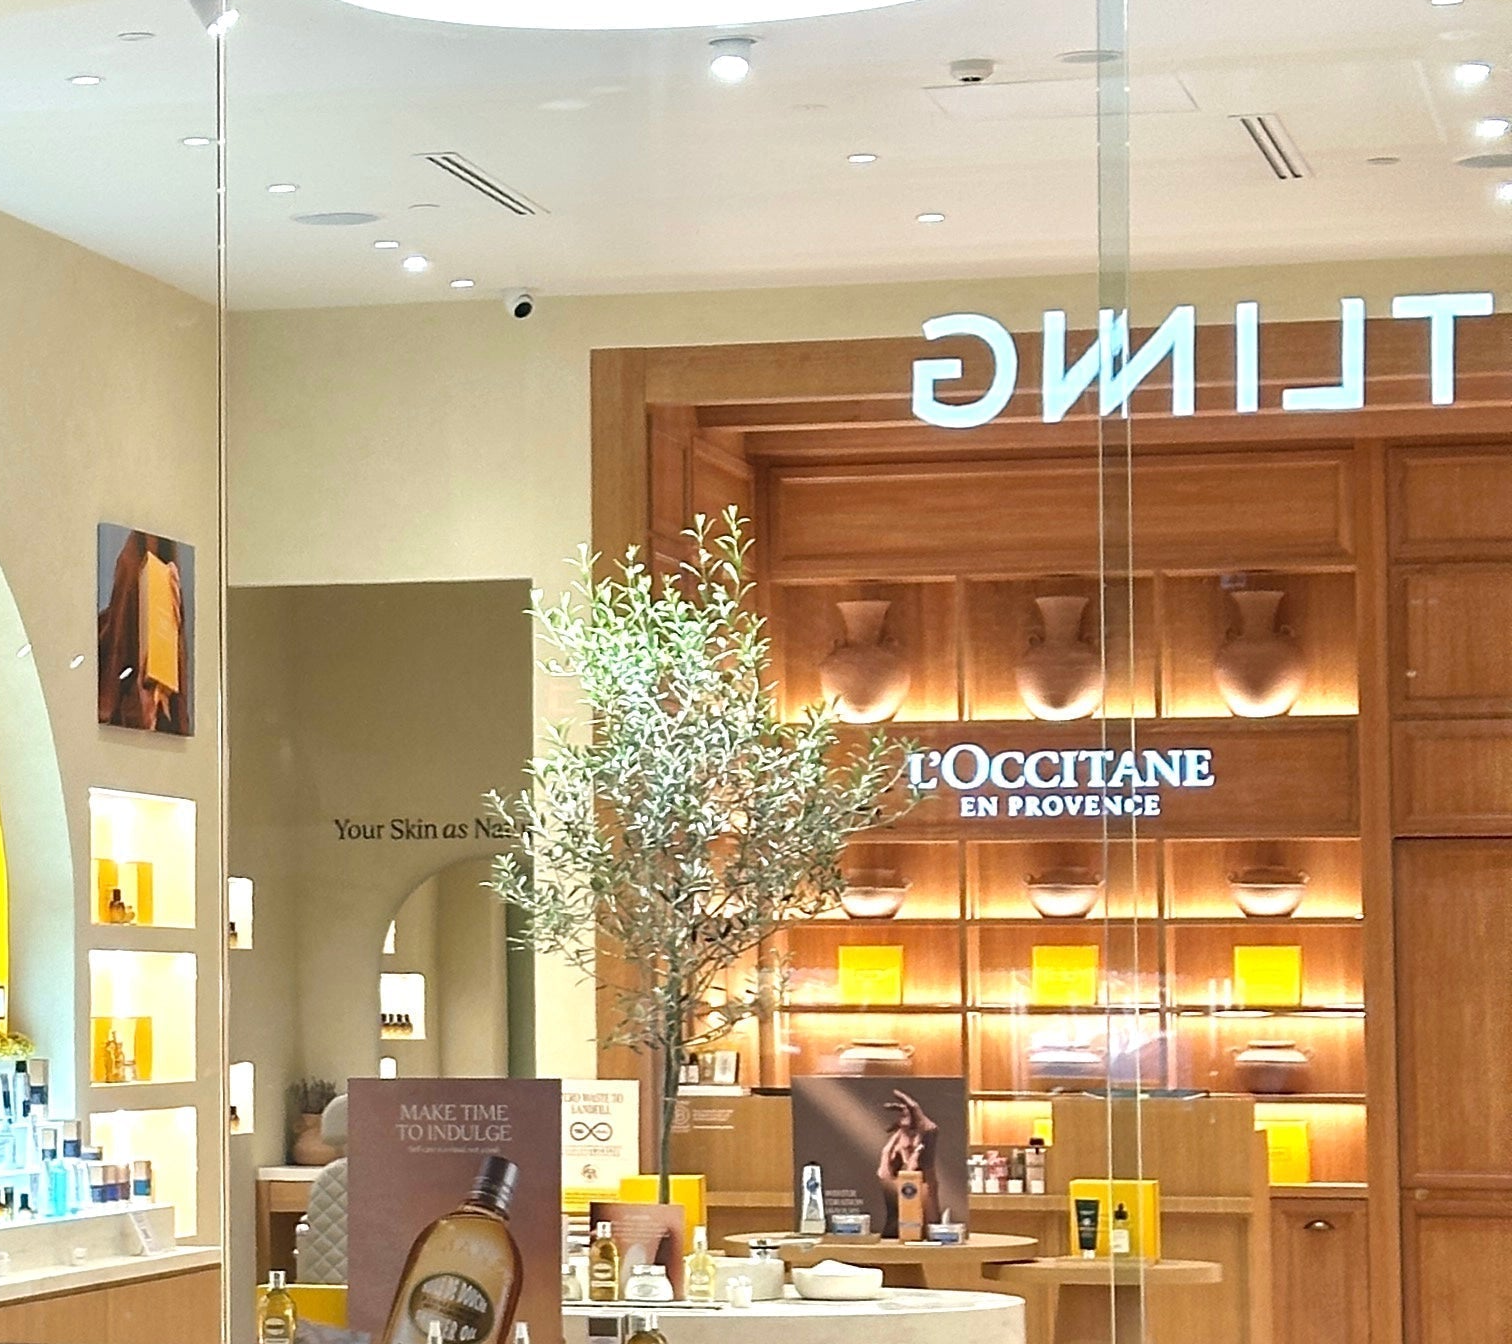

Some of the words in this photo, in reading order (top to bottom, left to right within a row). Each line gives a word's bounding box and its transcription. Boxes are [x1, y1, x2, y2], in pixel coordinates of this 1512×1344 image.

[908, 742, 1216, 790] L'OCCITANE
[960, 795, 999, 817] EN
[1007, 794, 1161, 817] PROVENCE
[334, 818, 385, 840] Your
[390, 818, 438, 841] Skin
[442, 823, 469, 840] as
[399, 1104, 457, 1121] MAKE
[462, 1104, 509, 1121] TIME
[395, 1123, 424, 1141] TO
[428, 1123, 513, 1142] INDULGE
